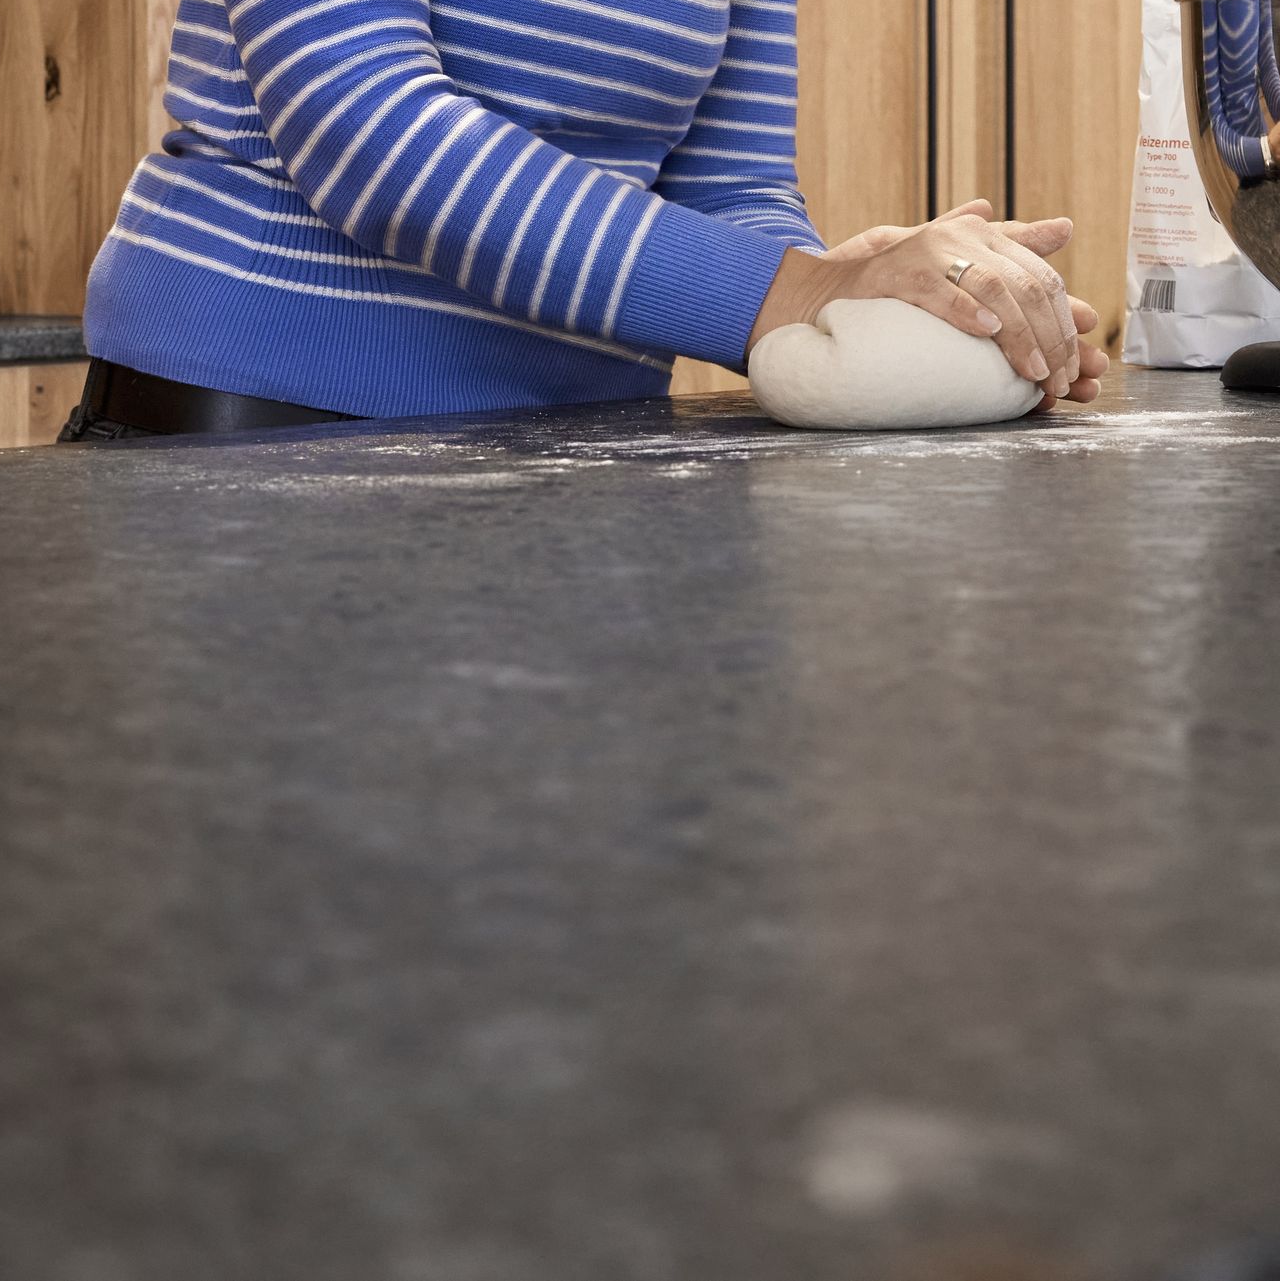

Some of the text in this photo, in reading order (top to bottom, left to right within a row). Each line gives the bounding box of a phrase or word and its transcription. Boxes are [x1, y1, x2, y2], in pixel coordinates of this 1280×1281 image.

[1140, 135, 1192, 149] eizenme
[1147, 152, 1177, 161] Type 700
[1152, 186, 1168, 195] 1000
